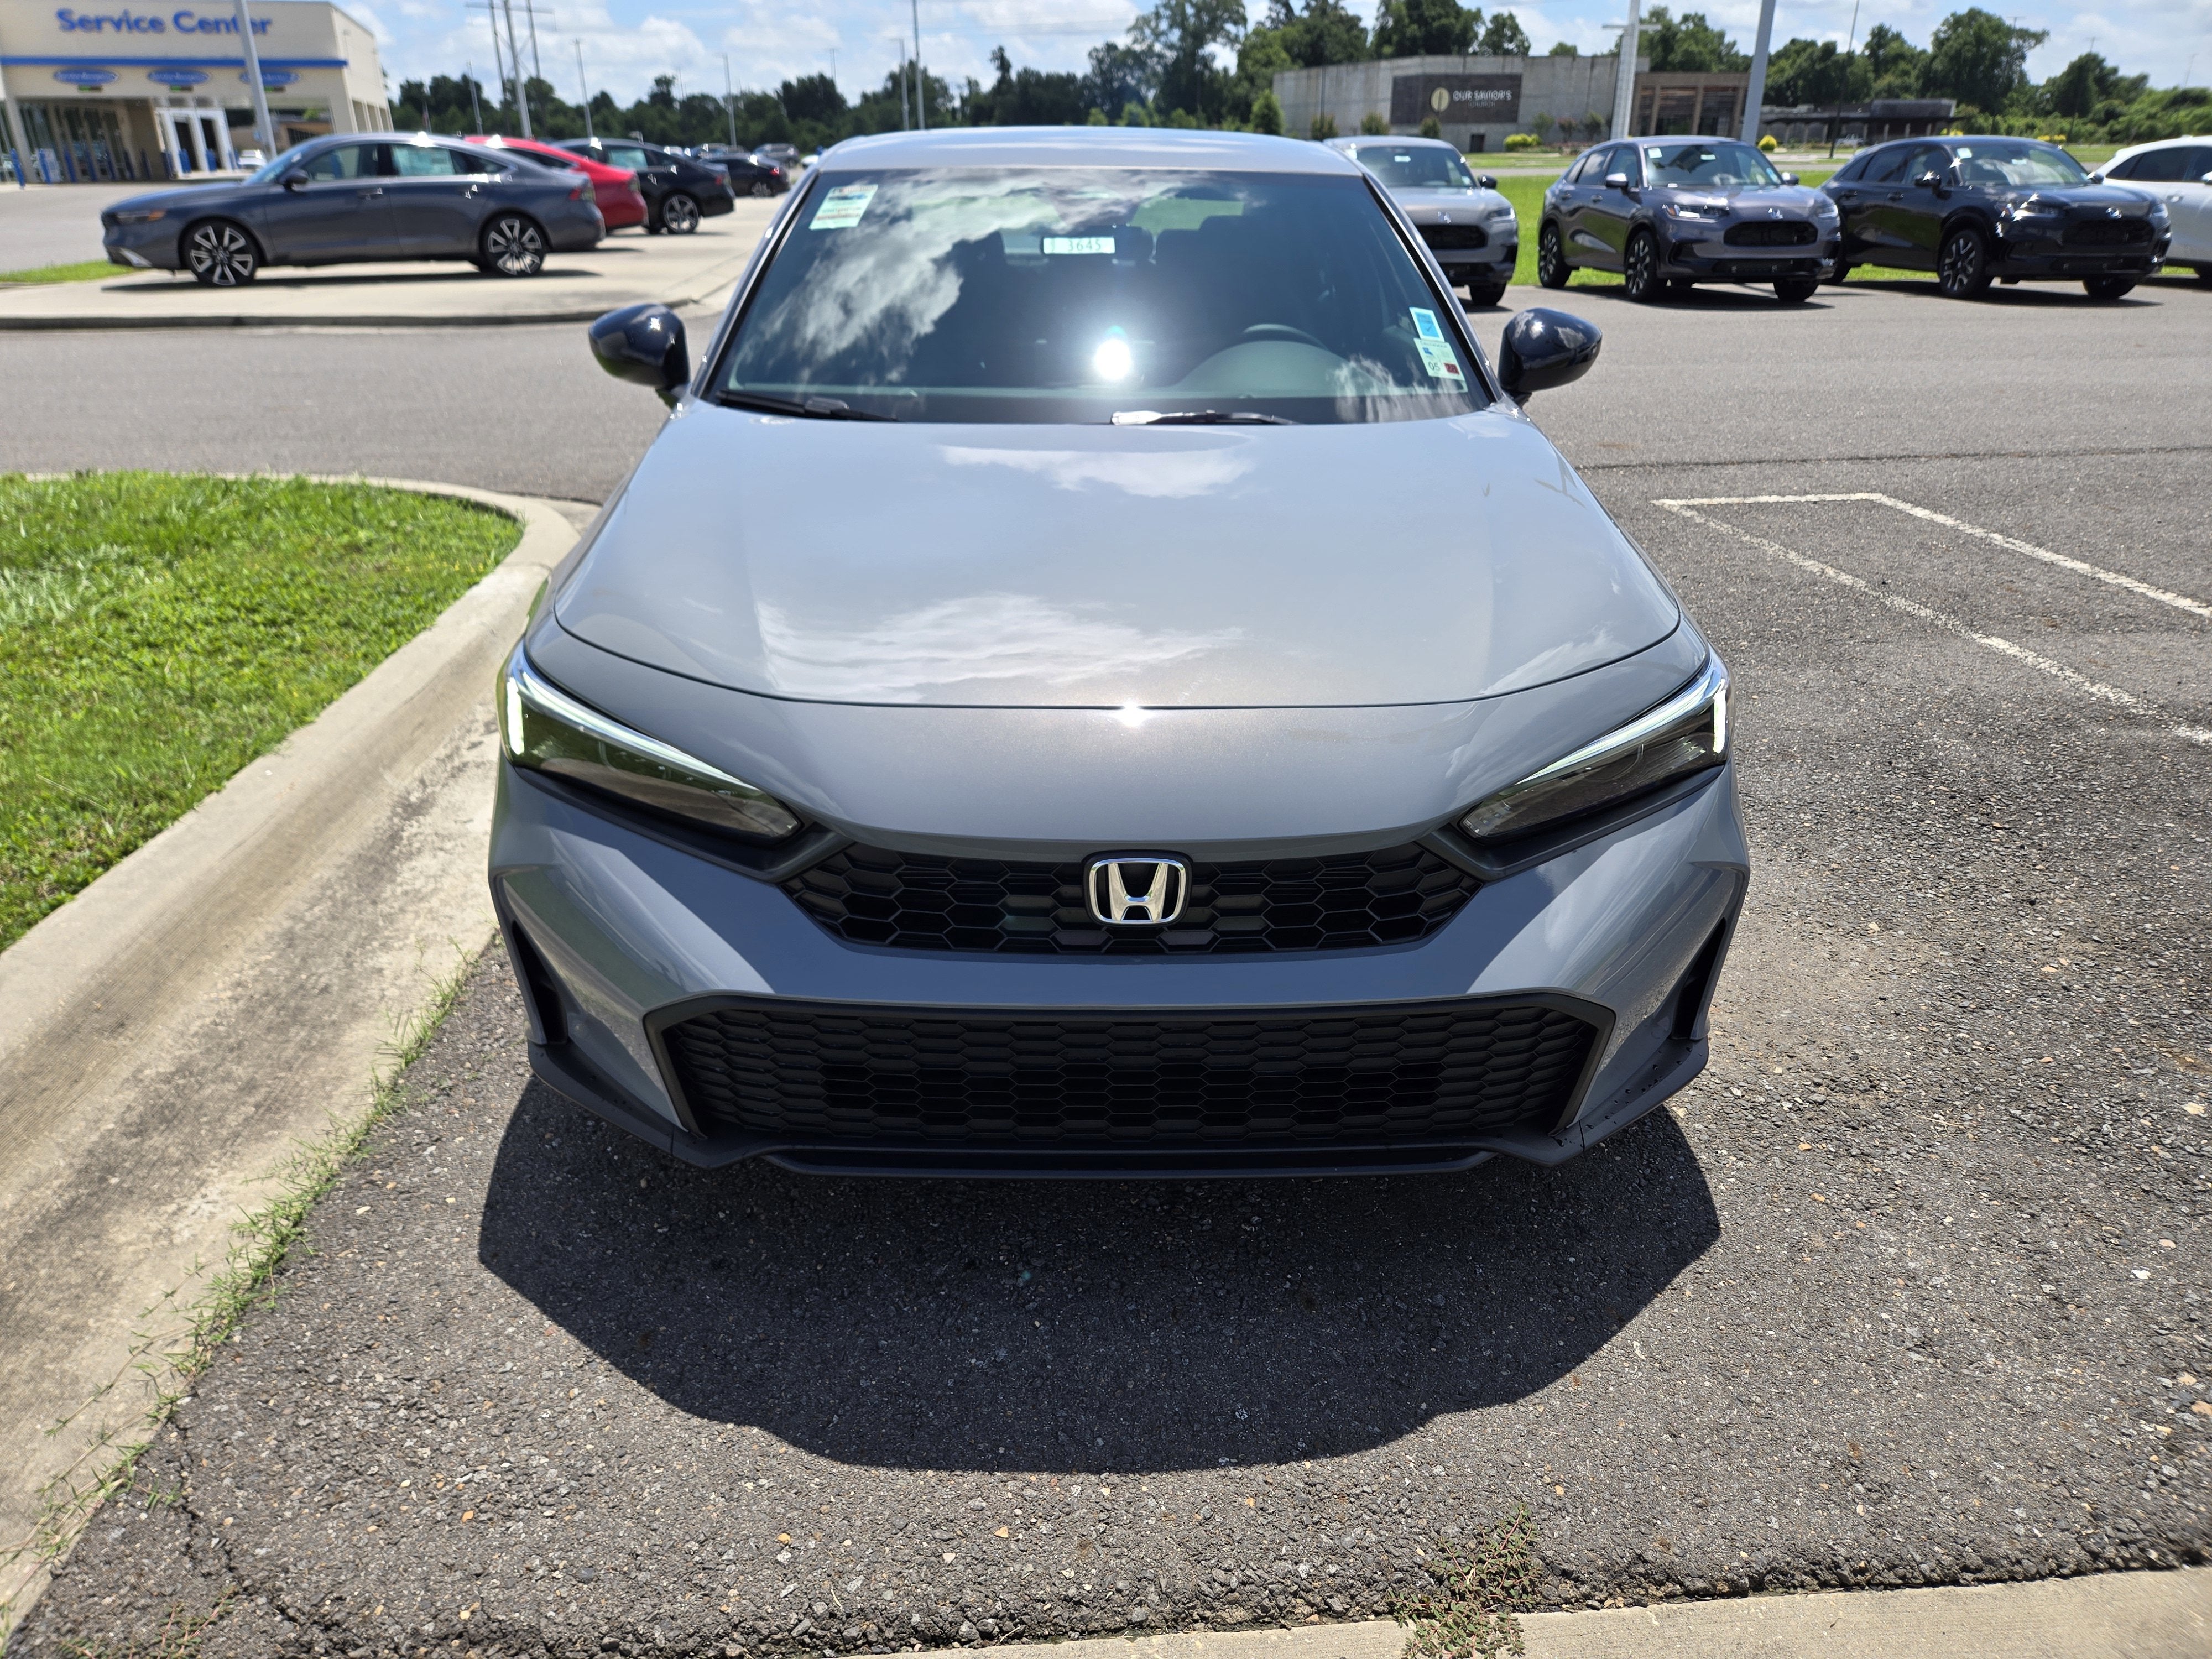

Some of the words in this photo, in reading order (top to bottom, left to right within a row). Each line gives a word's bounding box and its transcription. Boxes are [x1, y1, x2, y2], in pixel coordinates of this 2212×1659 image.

[55, 8, 165, 33] Service
[1453, 90, 1473, 101] OUR
[1068, 238, 1101, 252] 3645
